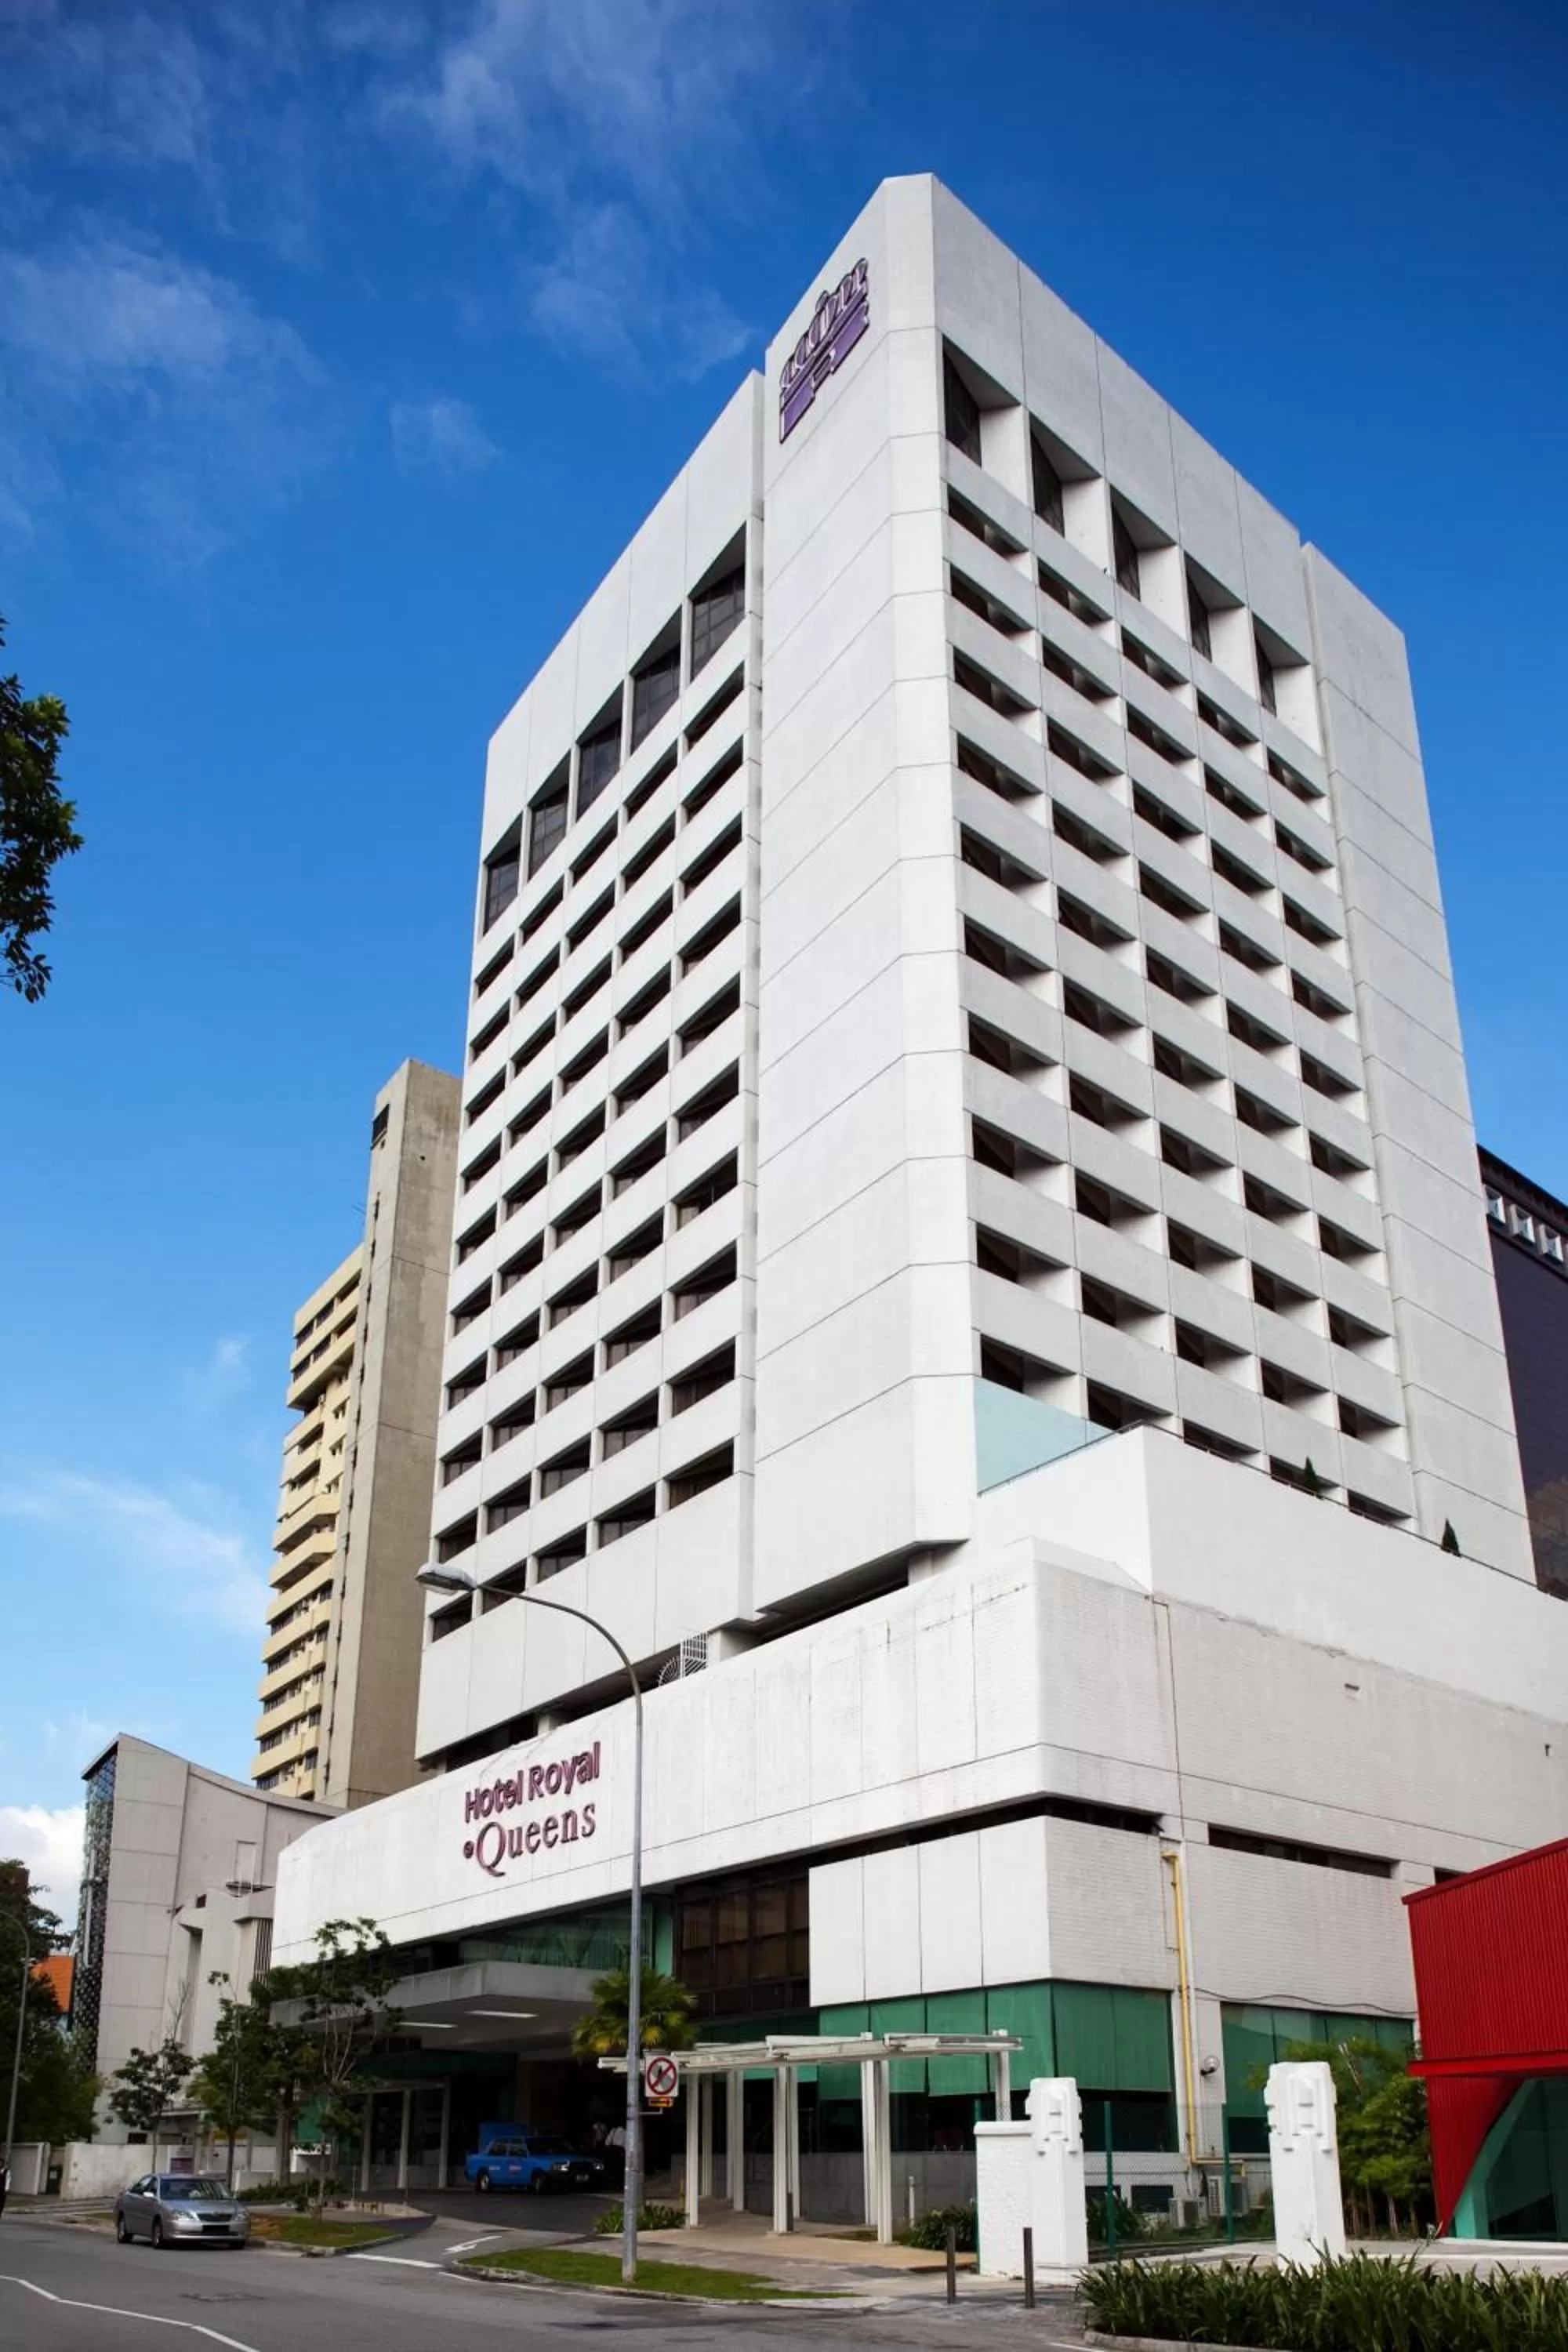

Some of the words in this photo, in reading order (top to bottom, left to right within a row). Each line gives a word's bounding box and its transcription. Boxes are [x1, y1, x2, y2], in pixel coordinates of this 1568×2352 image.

[465, 1769, 524, 1824] Hotel
[528, 1741, 601, 1801] Royal
[476, 1803, 596, 1877] Queens
